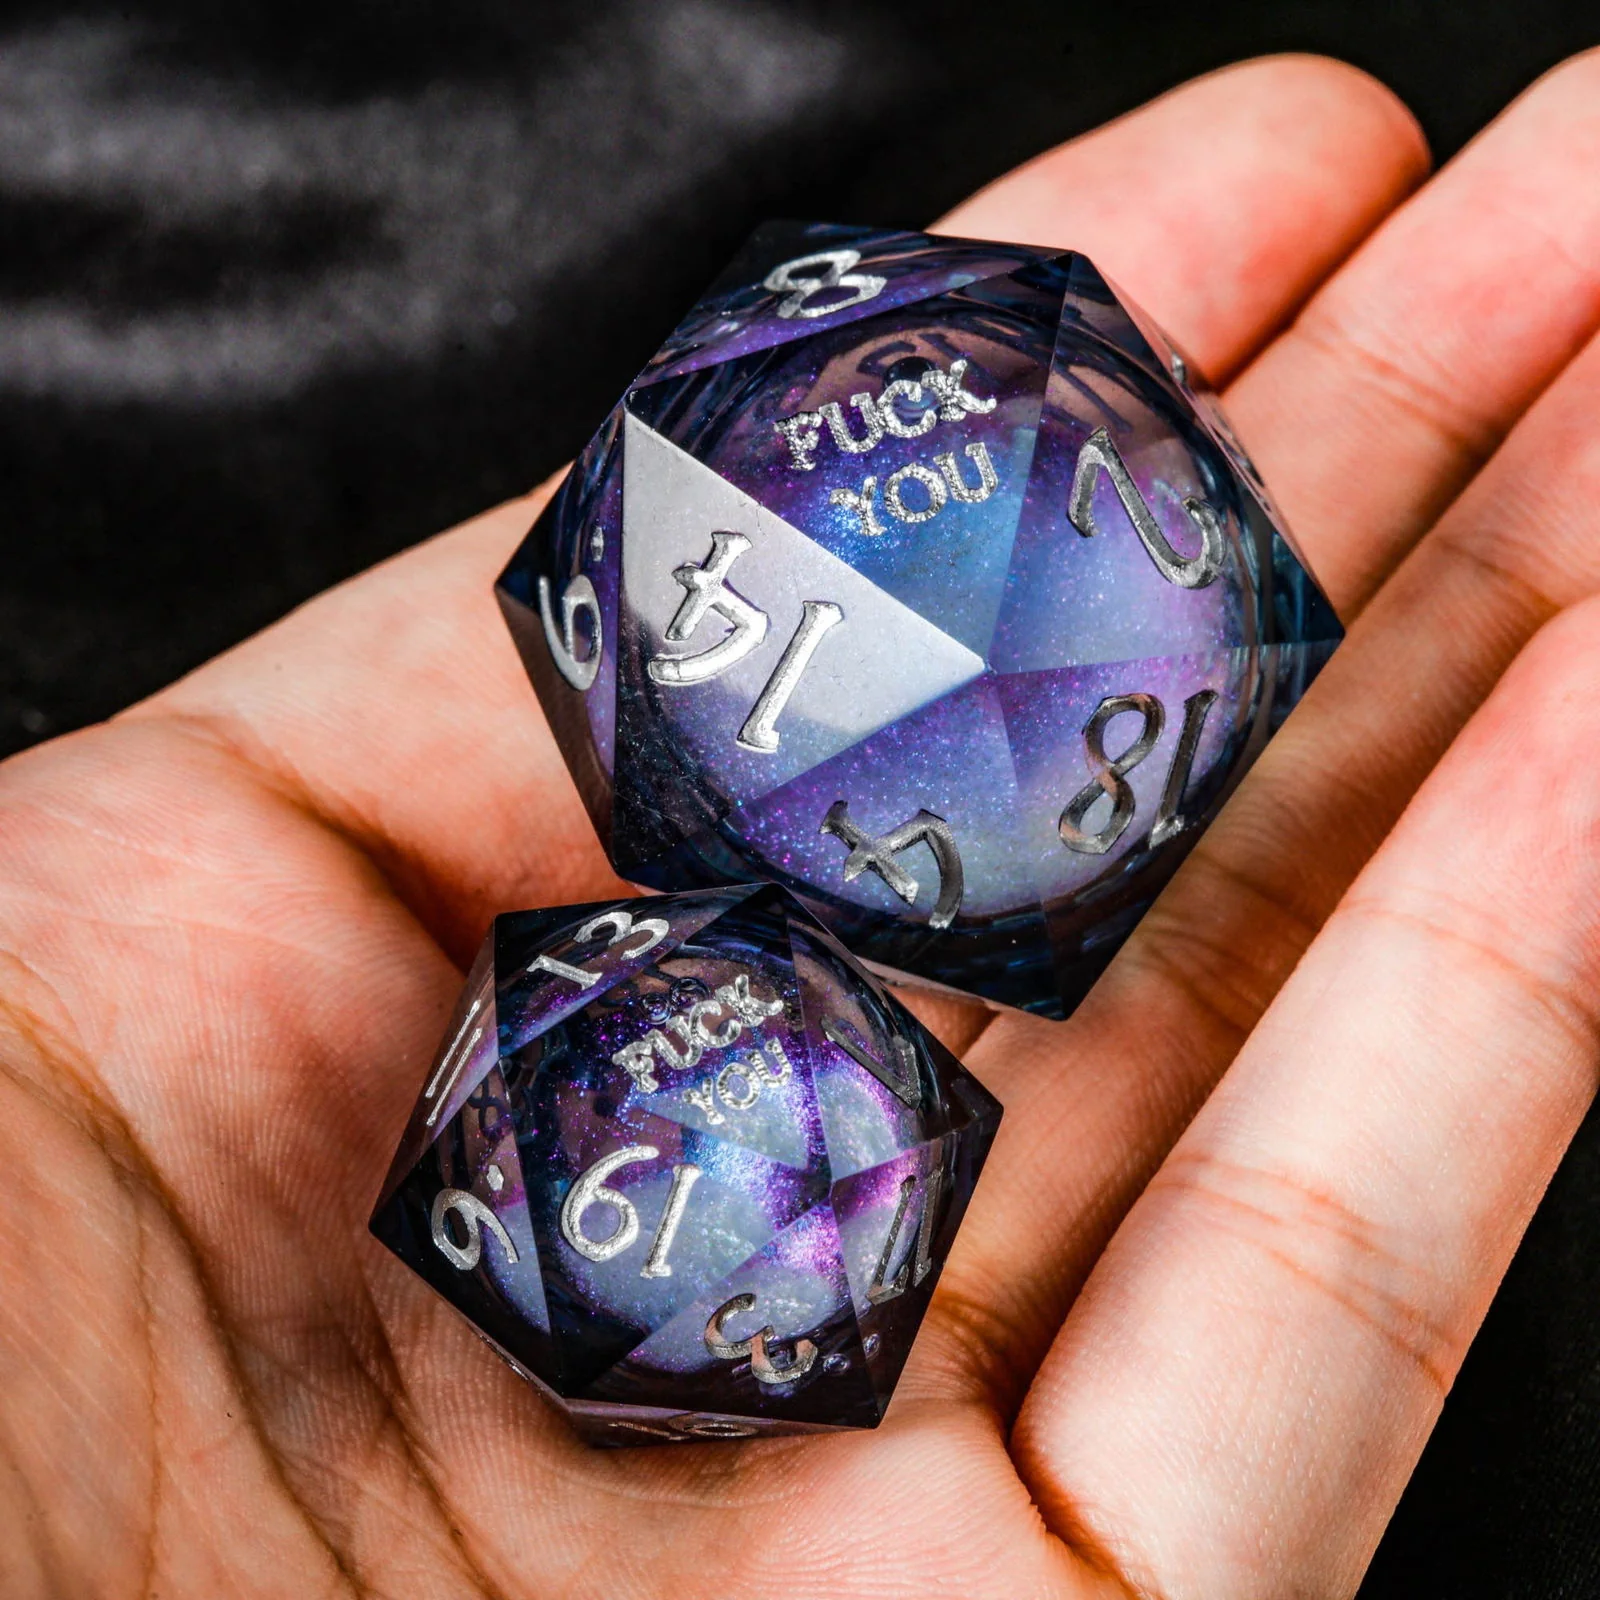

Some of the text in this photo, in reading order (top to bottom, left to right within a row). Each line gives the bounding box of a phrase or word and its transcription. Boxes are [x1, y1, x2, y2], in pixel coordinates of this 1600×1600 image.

[764, 250, 886, 319] 8
[774, 359, 997, 470] FUCK
[830, 442, 997, 536] YOU
[1058, 689, 1219, 854] 18
[819, 800, 964, 929] 4
[526, 911, 670, 991] 13
[612, 974, 784, 1093] FUCK
[682, 1037, 793, 1125] YOU
[704, 1292, 818, 1384] 3
